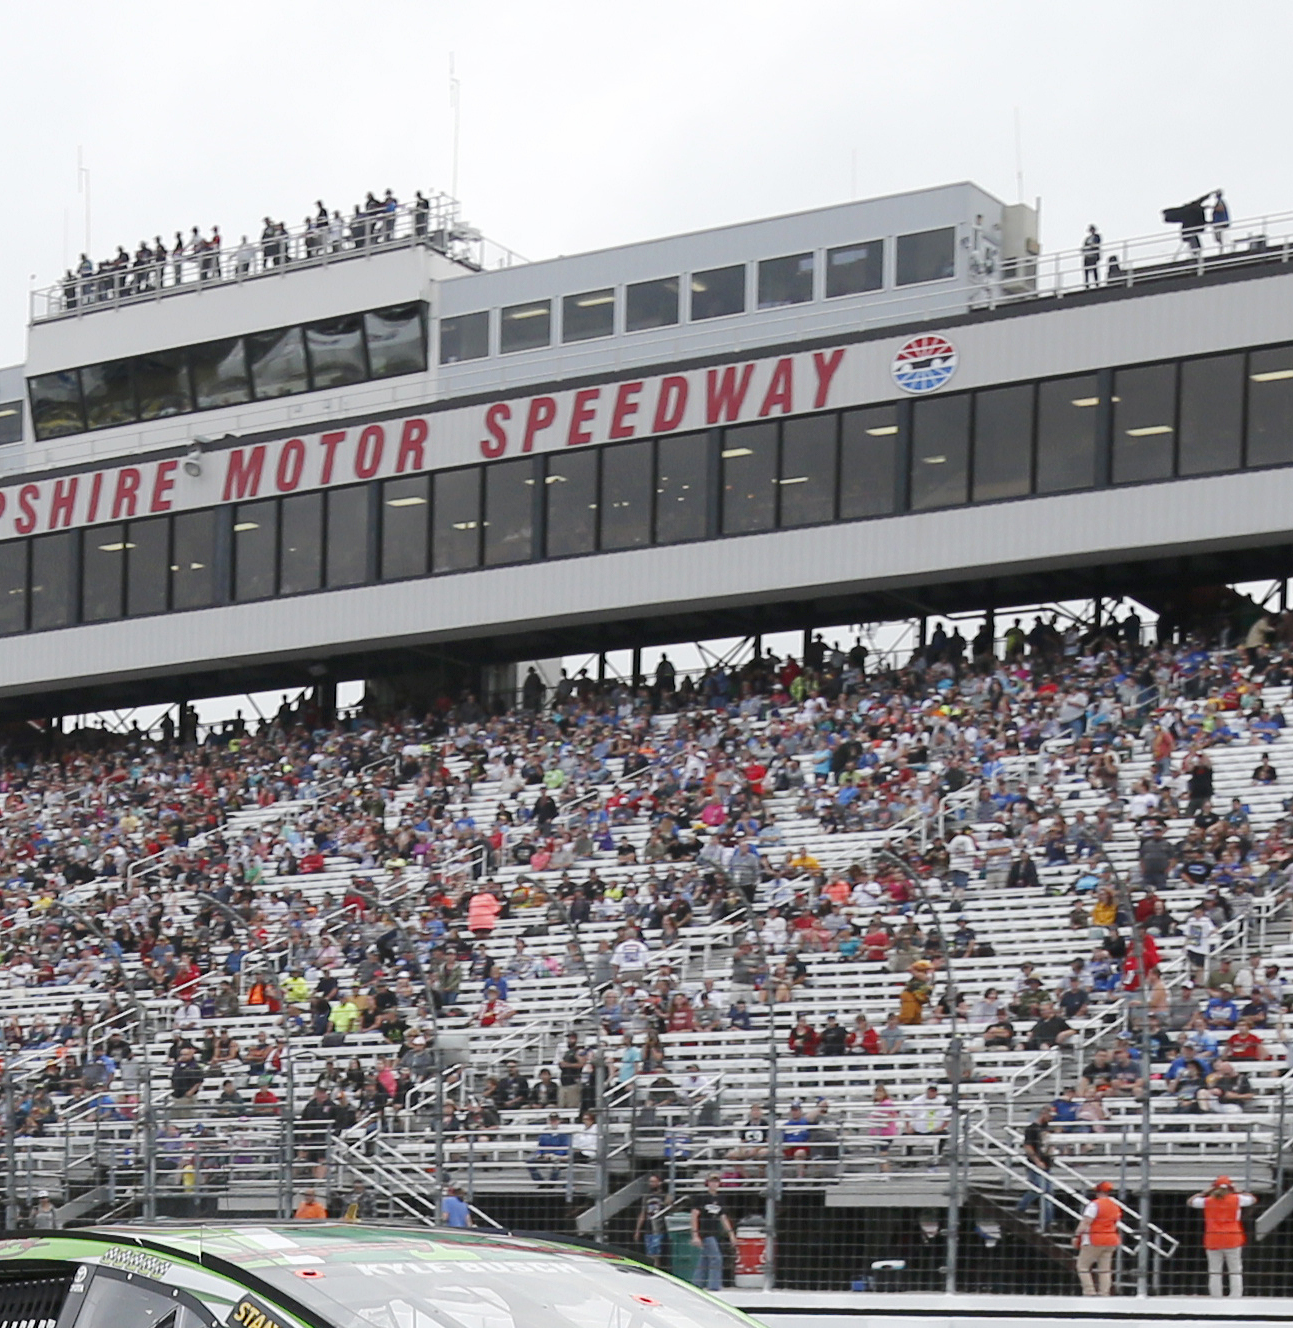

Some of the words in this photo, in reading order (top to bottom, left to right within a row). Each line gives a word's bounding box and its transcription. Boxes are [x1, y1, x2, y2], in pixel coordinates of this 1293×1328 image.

[222, 417, 430, 503] MOTOR
[479, 348, 845, 460] SPEEDWAY
[358, 1262, 454, 1277] KYLE
[460, 1262, 582, 1275] BUSCH
